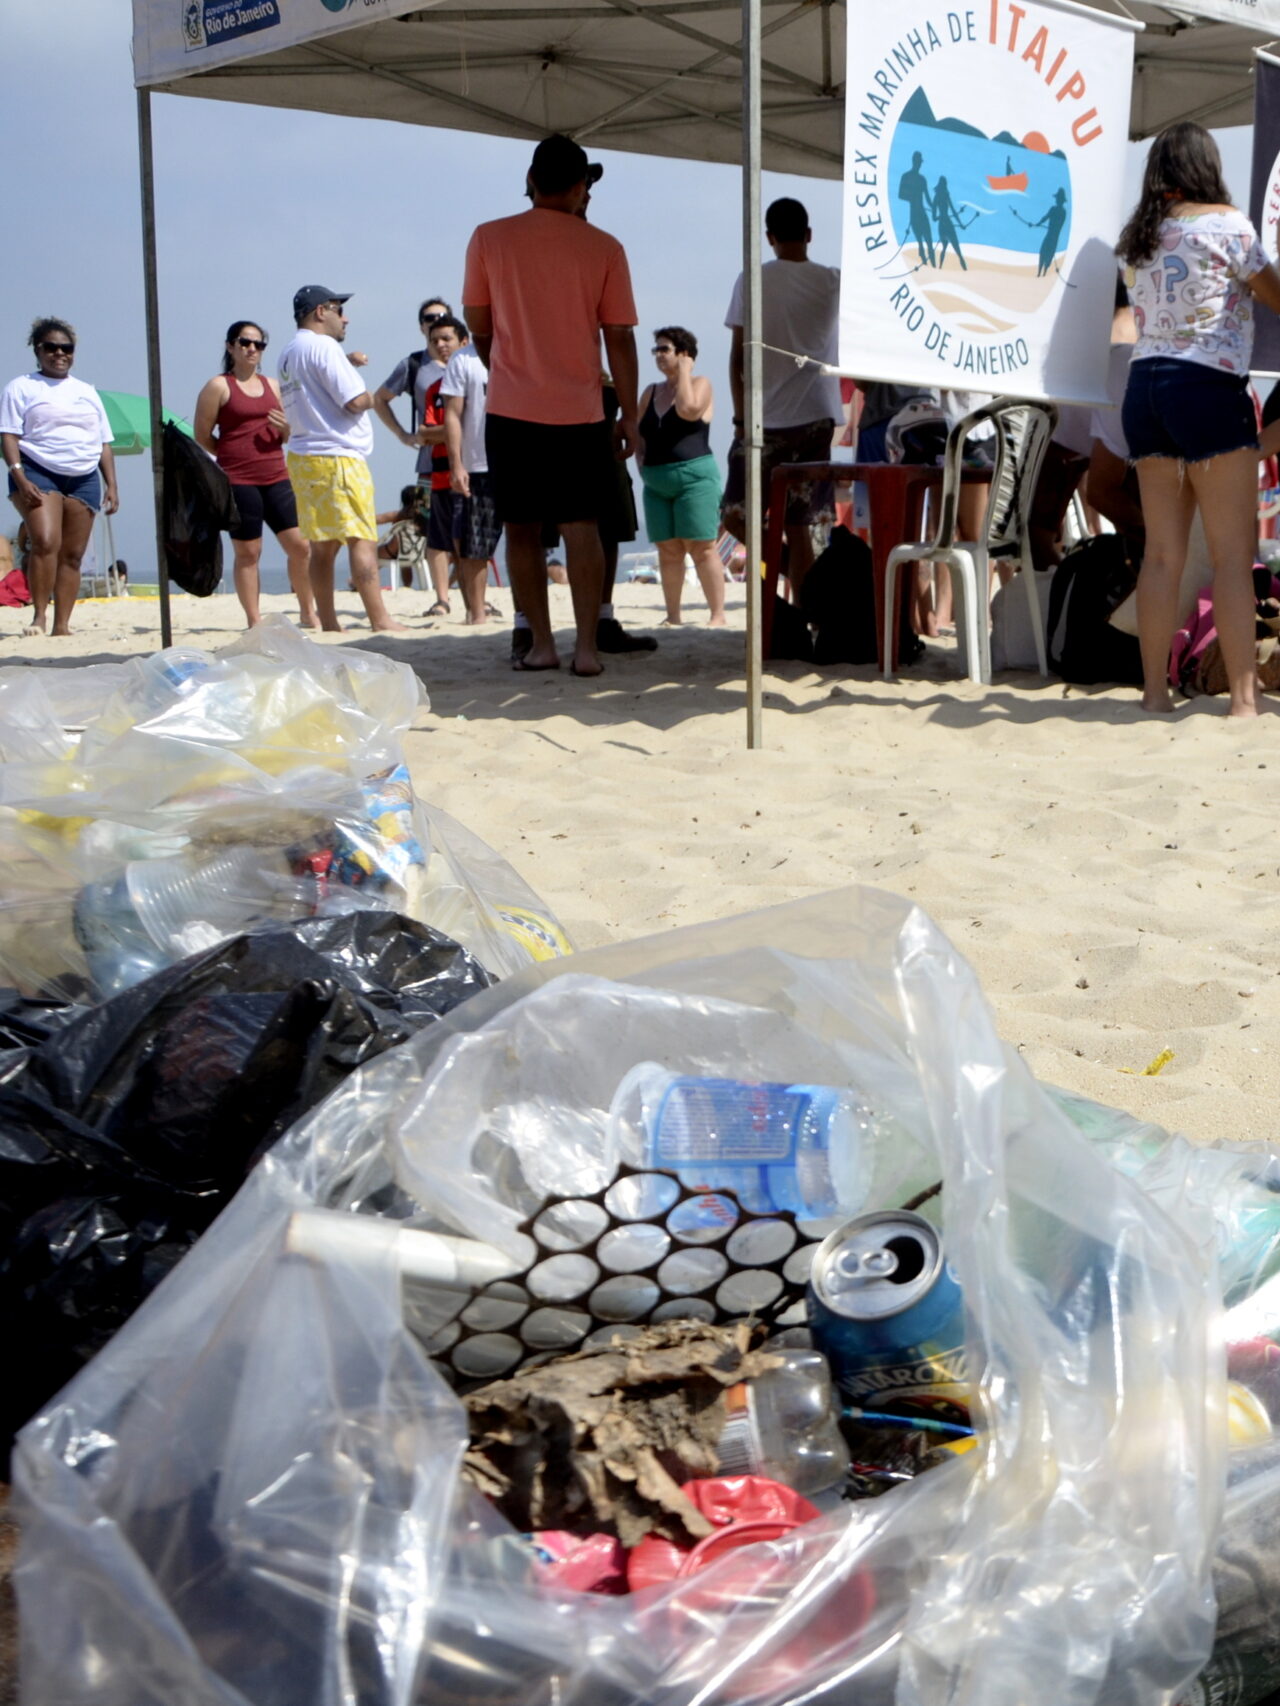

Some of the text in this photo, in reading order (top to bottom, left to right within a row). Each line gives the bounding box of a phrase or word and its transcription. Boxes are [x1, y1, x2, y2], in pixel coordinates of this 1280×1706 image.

[206, 2, 274, 35] Rio de Janeiro
[854, 0, 1103, 253] RESEX MARINHA DE ITAIPU
[889, 283, 1030, 376] RIO DE JANEIRO
